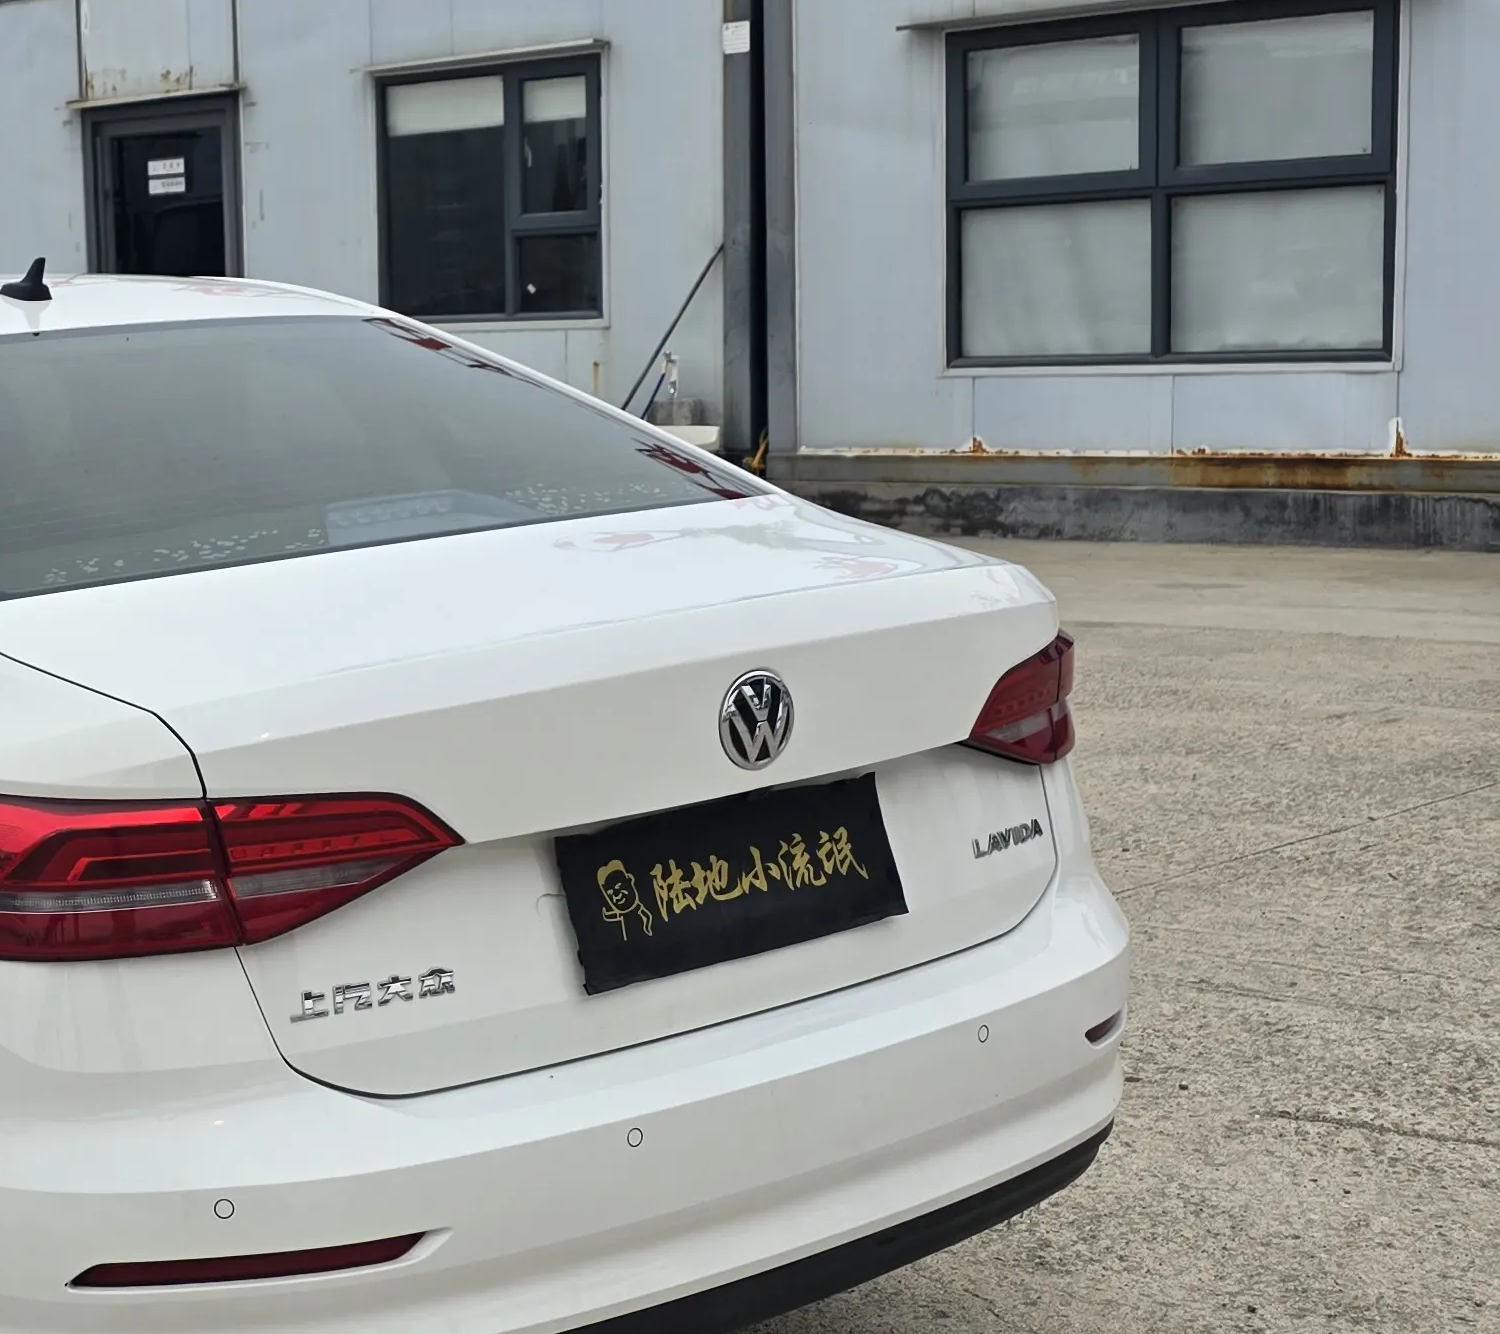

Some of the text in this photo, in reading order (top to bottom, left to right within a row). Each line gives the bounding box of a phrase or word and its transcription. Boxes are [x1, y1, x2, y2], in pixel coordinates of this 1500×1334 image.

[971, 818, 1044, 859] LAVIDA
[650, 825, 870, 922] 陆地小流氓
[289, 966, 456, 1024] 上汽大众
